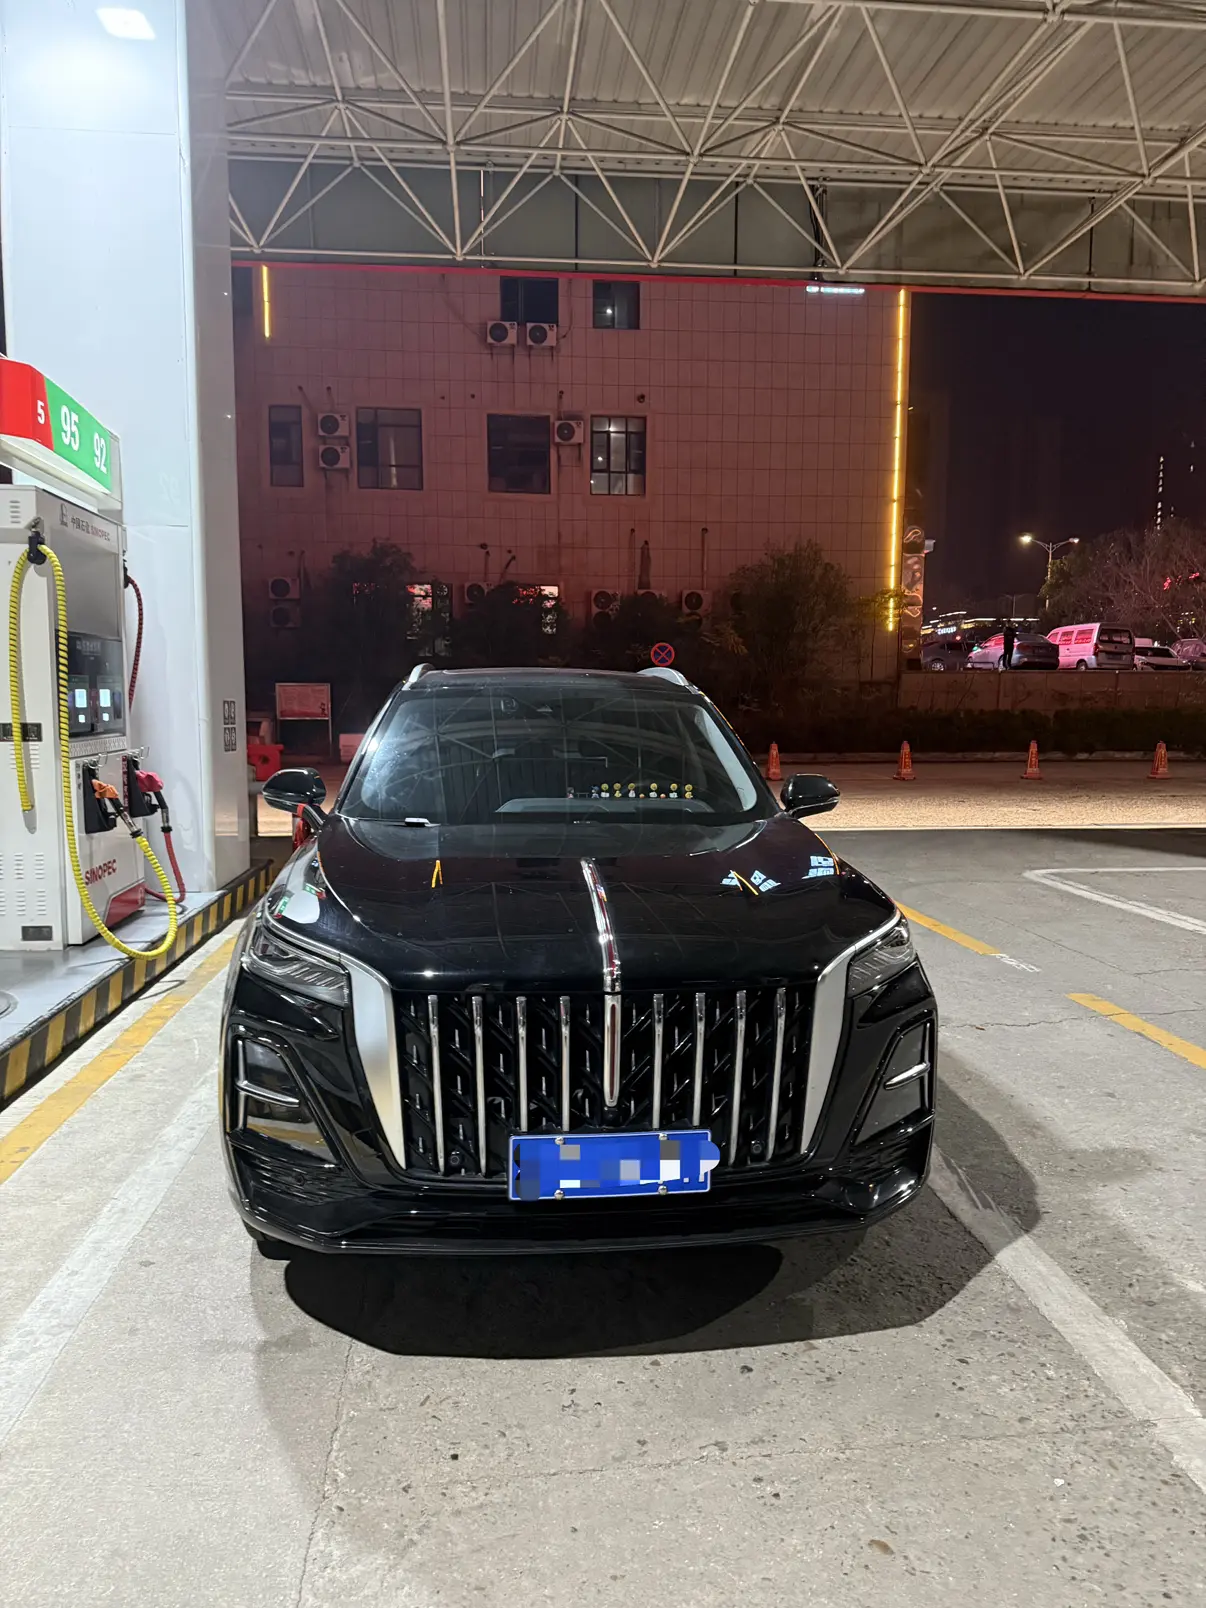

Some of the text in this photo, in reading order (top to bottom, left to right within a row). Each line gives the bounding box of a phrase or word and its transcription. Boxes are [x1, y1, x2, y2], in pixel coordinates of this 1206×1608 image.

[37, 399, 45, 424] 5
[60, 405, 107, 475] 95 92
[85, 859, 117, 886] SINOPEC
